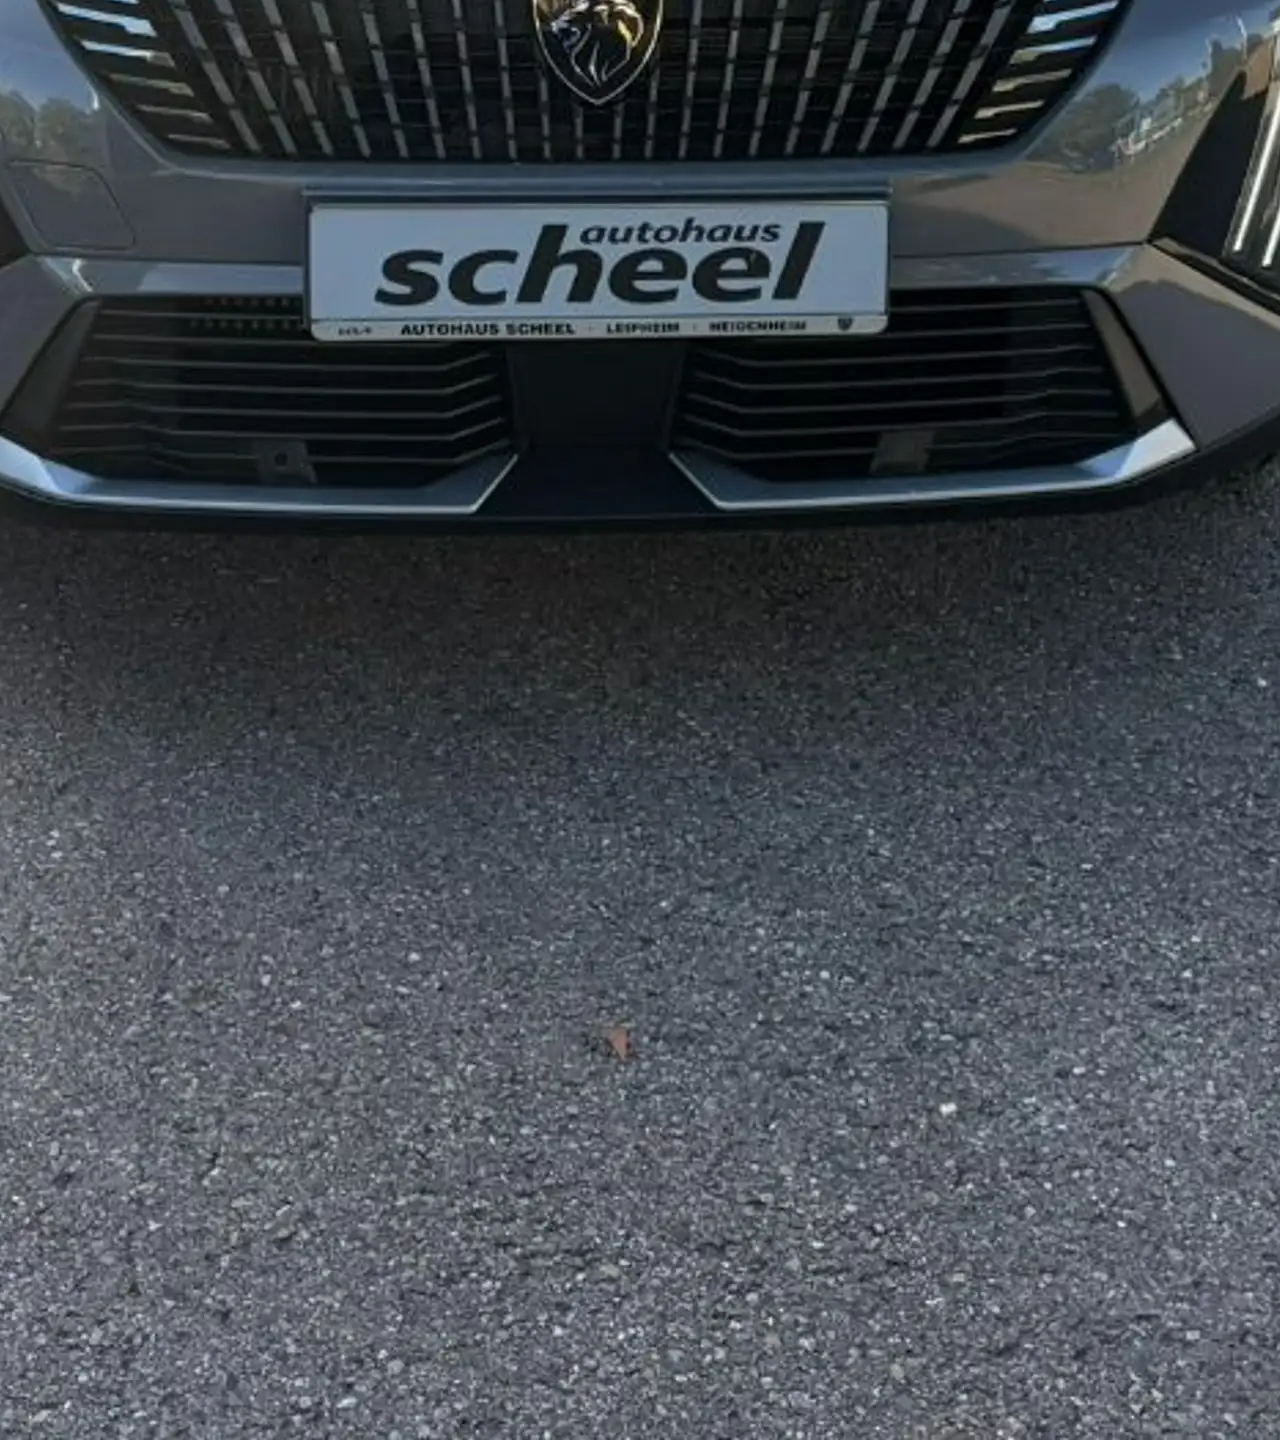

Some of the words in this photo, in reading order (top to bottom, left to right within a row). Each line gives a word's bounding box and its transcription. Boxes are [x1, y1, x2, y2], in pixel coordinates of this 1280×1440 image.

[580, 217, 781, 246] autohaus
[373, 221, 826, 306] scheel
[400, 323, 500, 336] AUTOHAUS
[505, 323, 576, 336] SCHEEL
